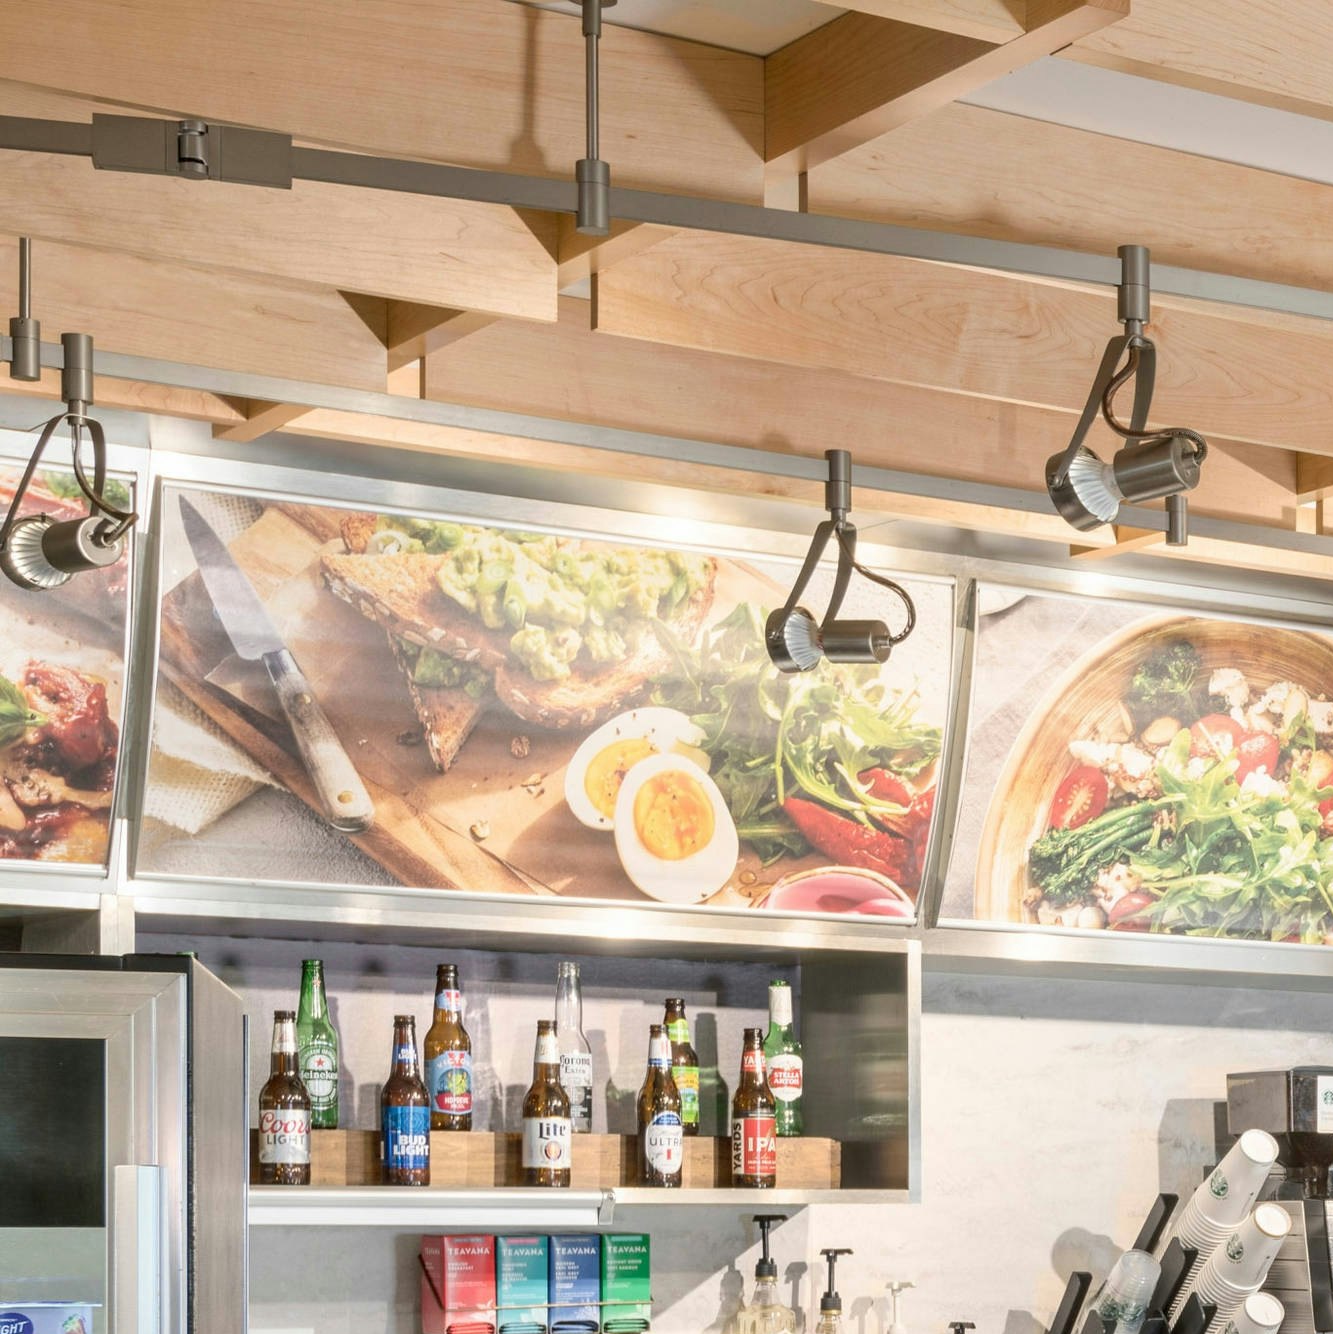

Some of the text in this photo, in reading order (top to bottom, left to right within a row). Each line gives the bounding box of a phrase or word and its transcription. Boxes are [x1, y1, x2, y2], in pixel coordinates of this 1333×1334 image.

[260, 1111, 312, 1135] Coors
[538, 1121, 566, 1140] Lite
[266, 1134, 305, 1145] LIGHT
[399, 1134, 427, 1145] BUD
[747, 1137, 776, 1152] IPA
[393, 1144, 429, 1156] LIGHT
[733, 1122, 742, 1170] YARDS
[448, 1247, 490, 1256] TEAVANA
[502, 1248, 544, 1256] TEAVANA
[556, 1247, 597, 1255] TEAVANA
